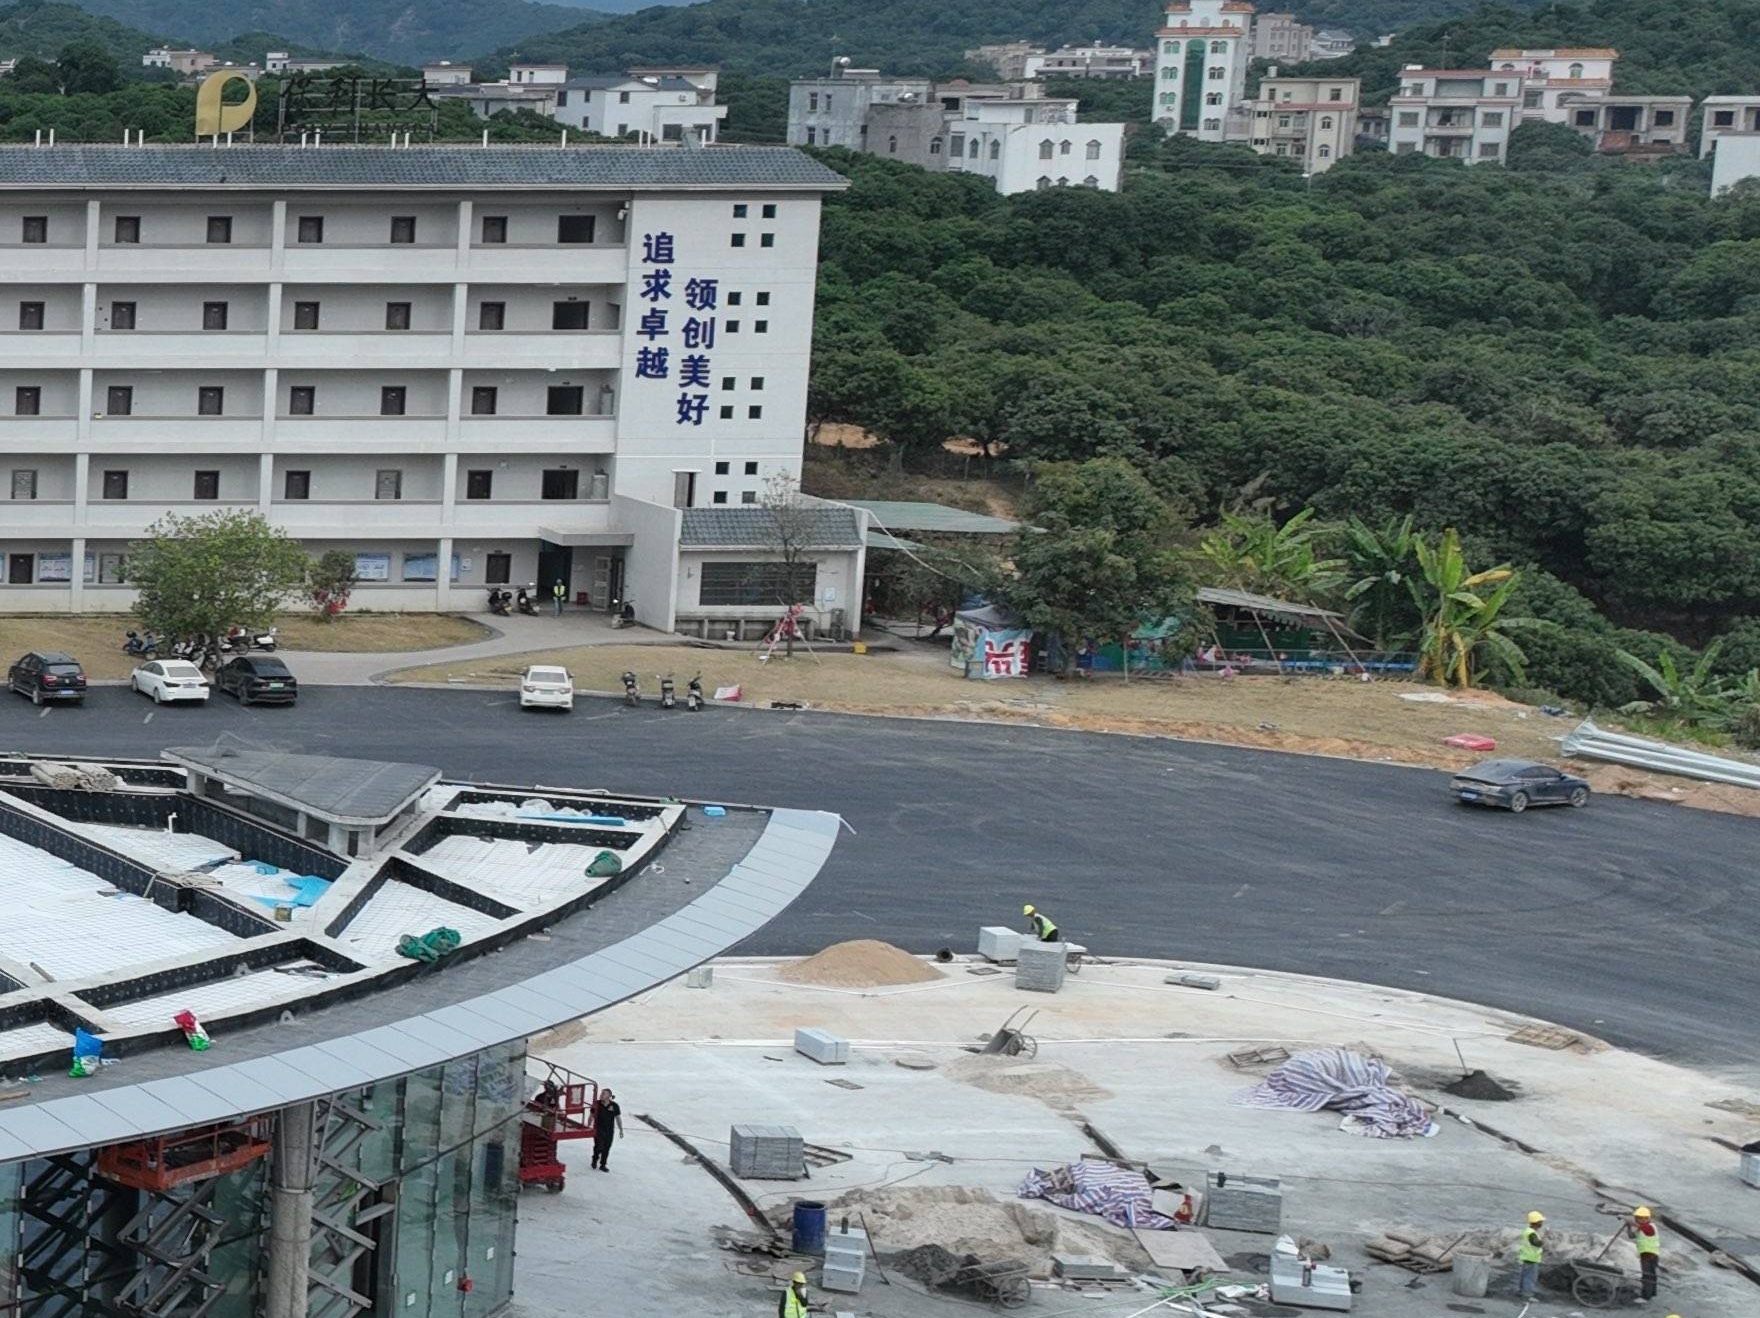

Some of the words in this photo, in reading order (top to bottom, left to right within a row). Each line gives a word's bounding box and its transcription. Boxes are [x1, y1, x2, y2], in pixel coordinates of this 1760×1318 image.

[636, 232, 675, 379] 追求卓越
[676, 278, 718, 426] 领创美好
